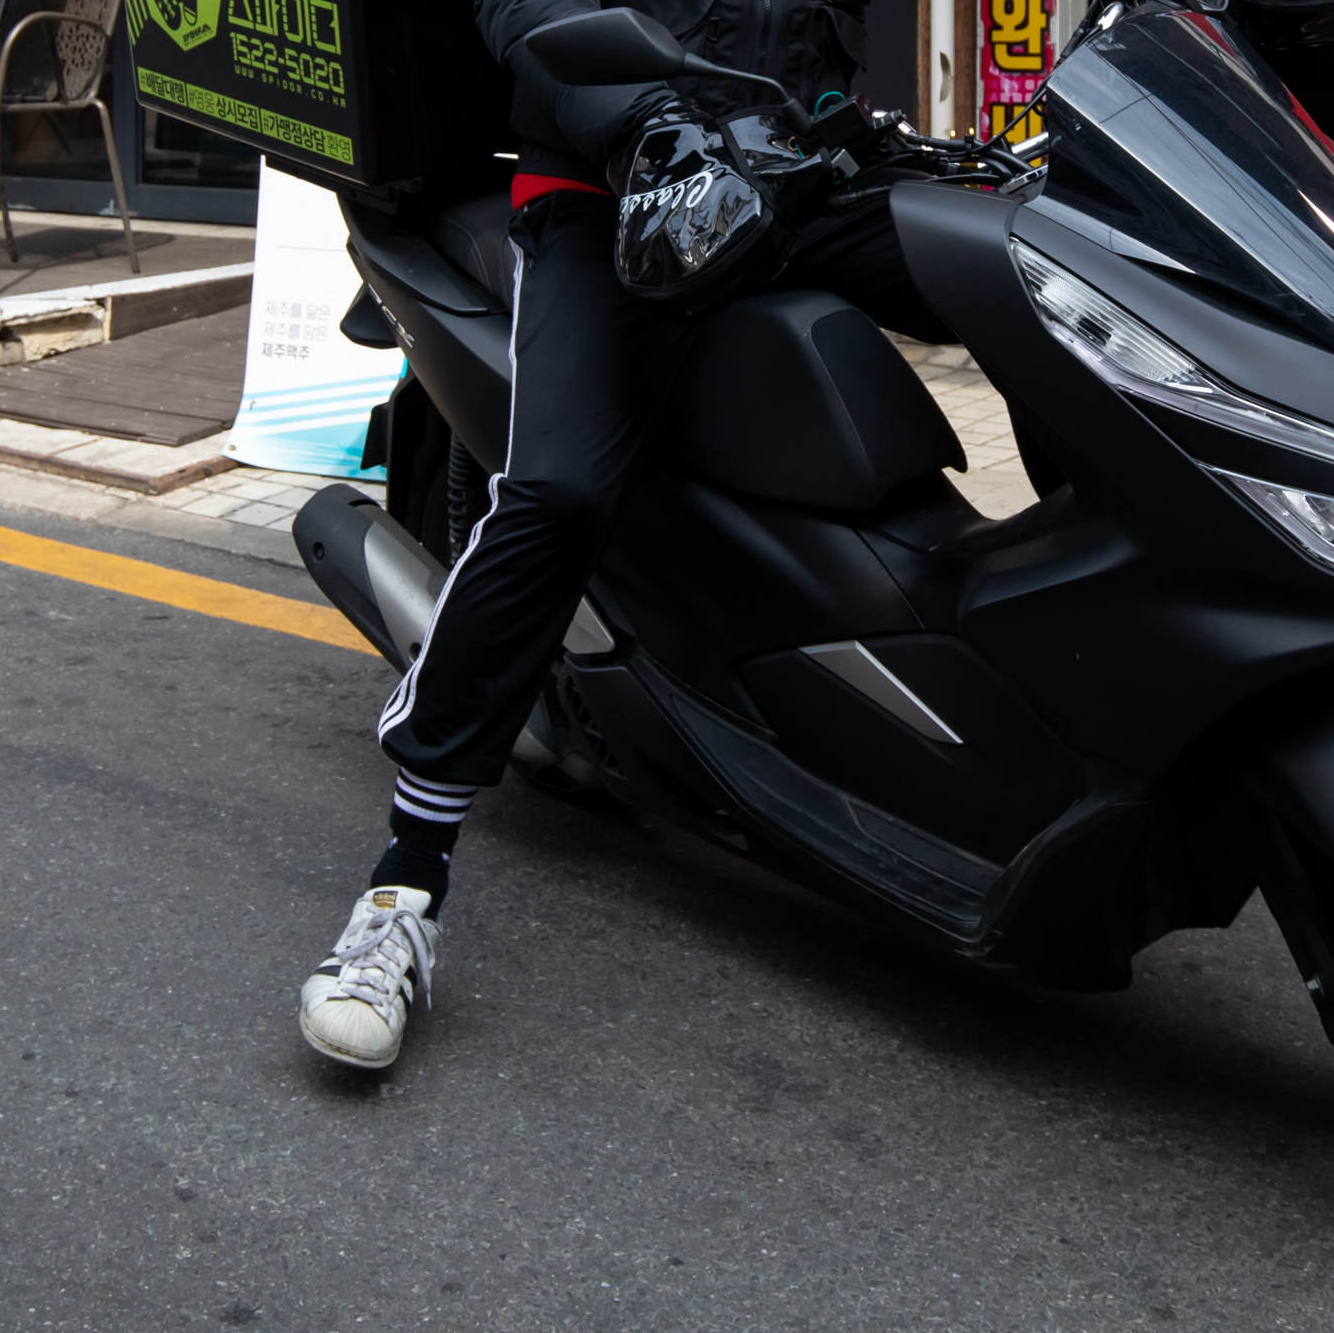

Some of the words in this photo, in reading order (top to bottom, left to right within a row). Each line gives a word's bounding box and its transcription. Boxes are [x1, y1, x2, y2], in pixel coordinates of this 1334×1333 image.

[229, 32, 345, 95] 1522-5020
[140, 71, 186, 104] #배달대행
[216, 99, 259, 131] 상시모집
[263, 114, 326, 153] #가맹점상담
[327, 134, 351, 163] 환영
[261, 342, 310, 360] 제주맥주
